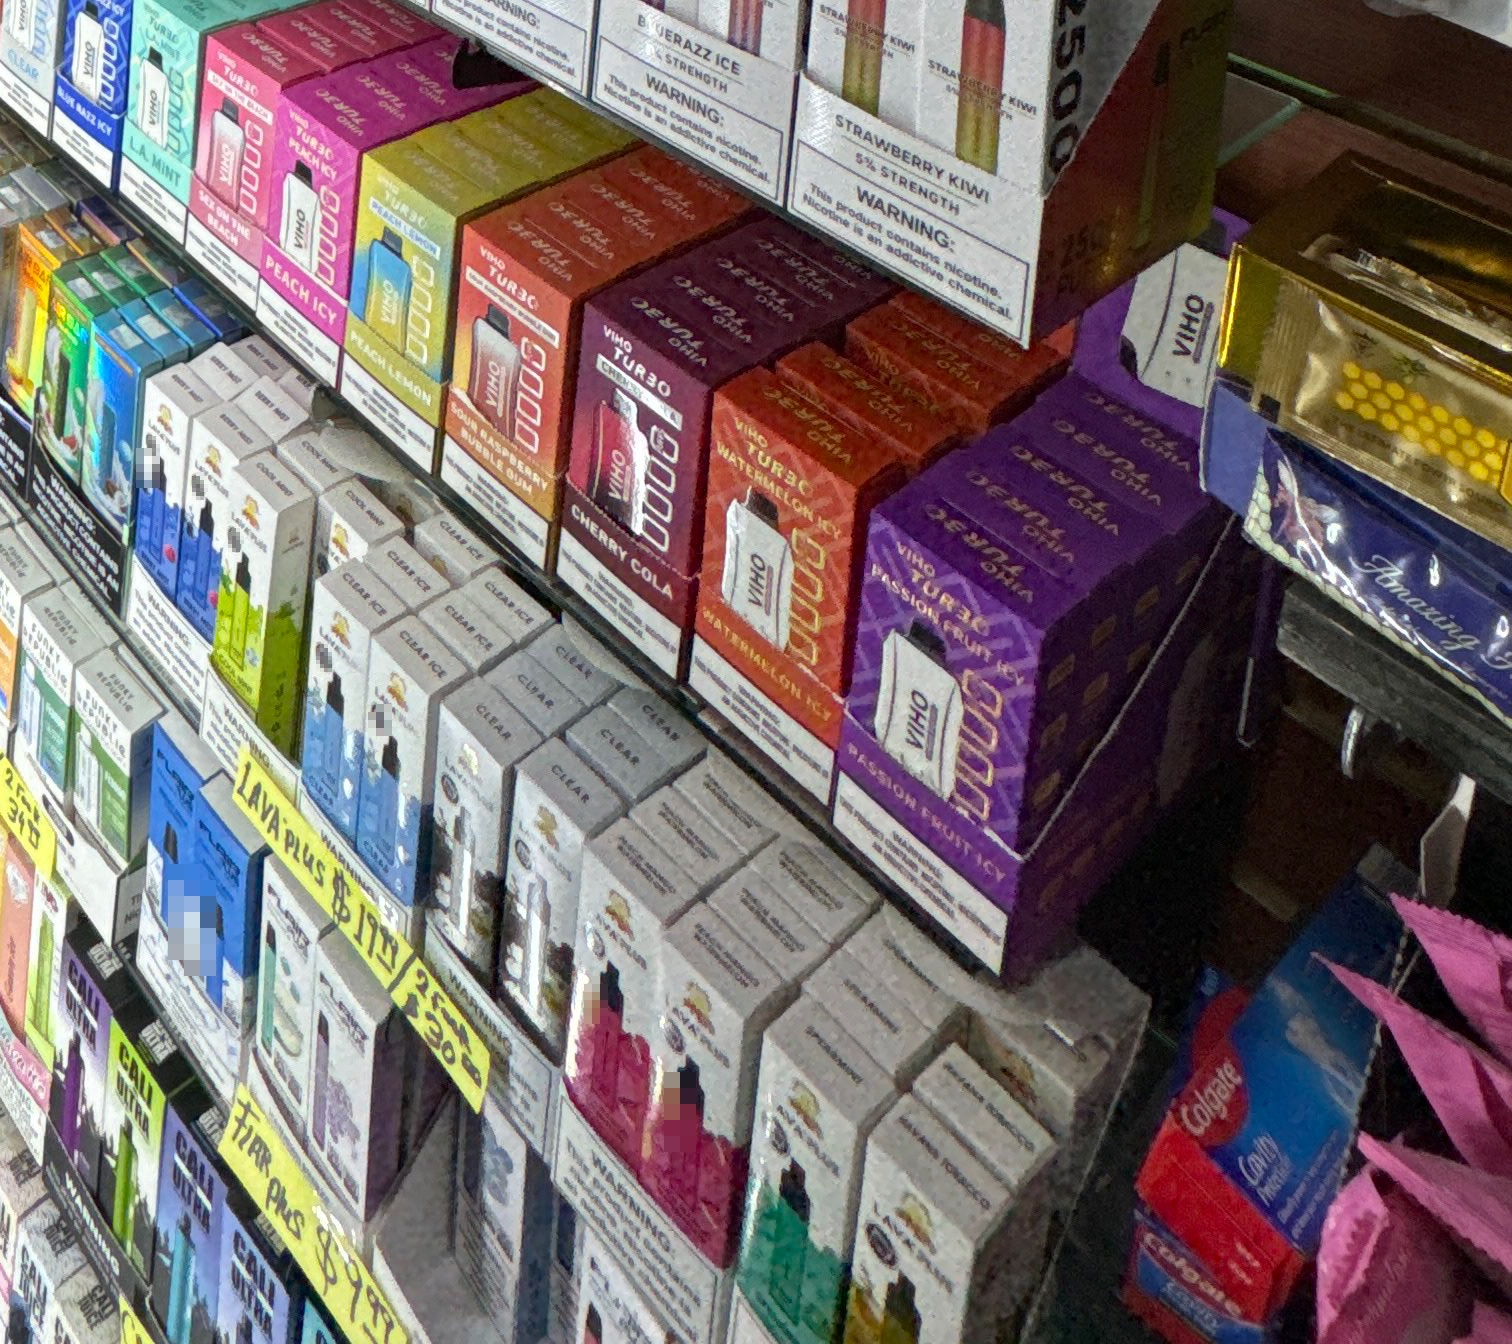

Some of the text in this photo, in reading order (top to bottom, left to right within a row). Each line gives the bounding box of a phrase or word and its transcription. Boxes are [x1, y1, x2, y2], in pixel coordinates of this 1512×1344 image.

[835, 114, 989, 204] STRAWBERRY KIWI
[855, 153, 960, 216] 5% STRENGTH
[810, 183, 1002, 300] This product contains nicotine.
[857, 185, 956, 252] WARNING:
[265, 253, 338, 328] PEACH ICY
[1173, 293, 1204, 359] VIHO
[349, 329, 432, 407] PEACH LEMON
[570, 505, 674, 601] CHERRY COLA
[1360, 553, 1481, 652] Amazing
[905, 690, 925, 749] VIHO
[847, 742, 917, 810] PASSION
[976, 853, 1006, 883] ICY
[119, 1041, 153, 1110] CALI
[1179, 1058, 1244, 1139] Colgate
